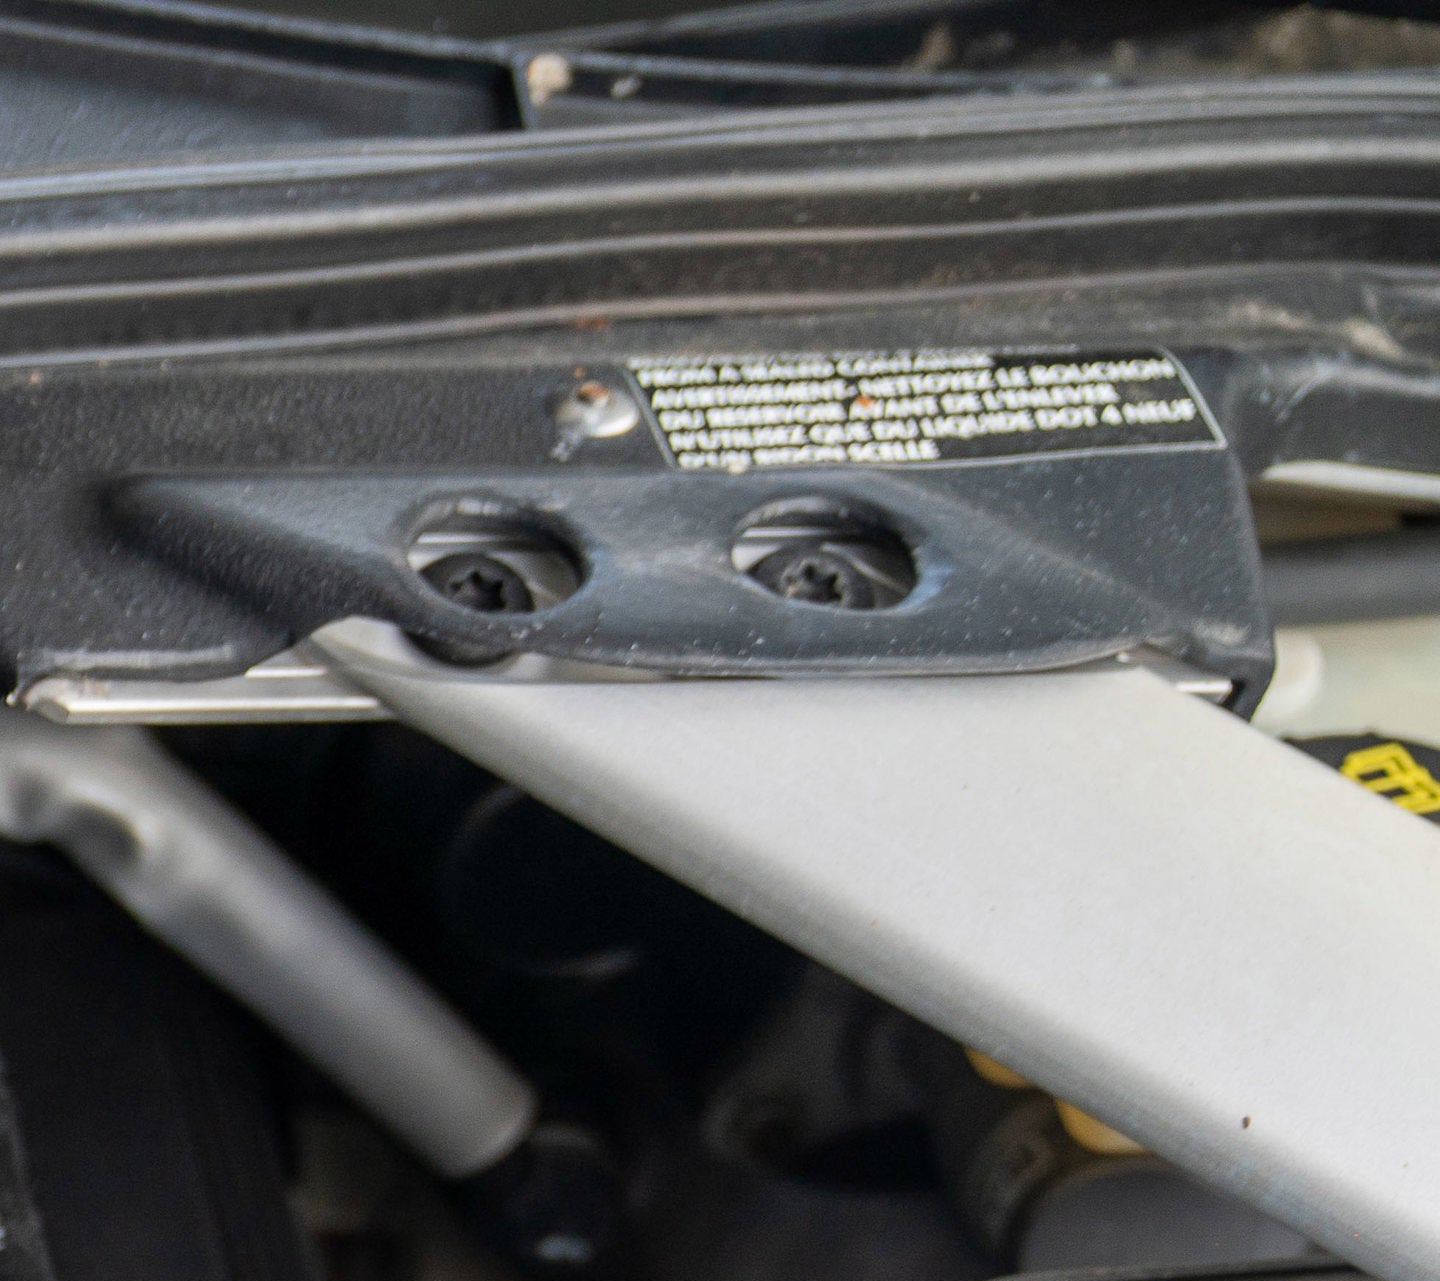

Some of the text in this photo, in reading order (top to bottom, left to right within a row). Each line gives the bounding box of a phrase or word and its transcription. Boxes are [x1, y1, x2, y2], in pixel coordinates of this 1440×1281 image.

[996, 367, 1028, 387] LE
[1029, 358, 1176, 383] BOUCHON
[940, 393, 982, 413] DE
[920, 410, 1035, 438] LIQUIDE
[1035, 405, 1098, 429] DOT
[1100, 403, 1123, 425] 4
[1122, 398, 1196, 424] NEUF
